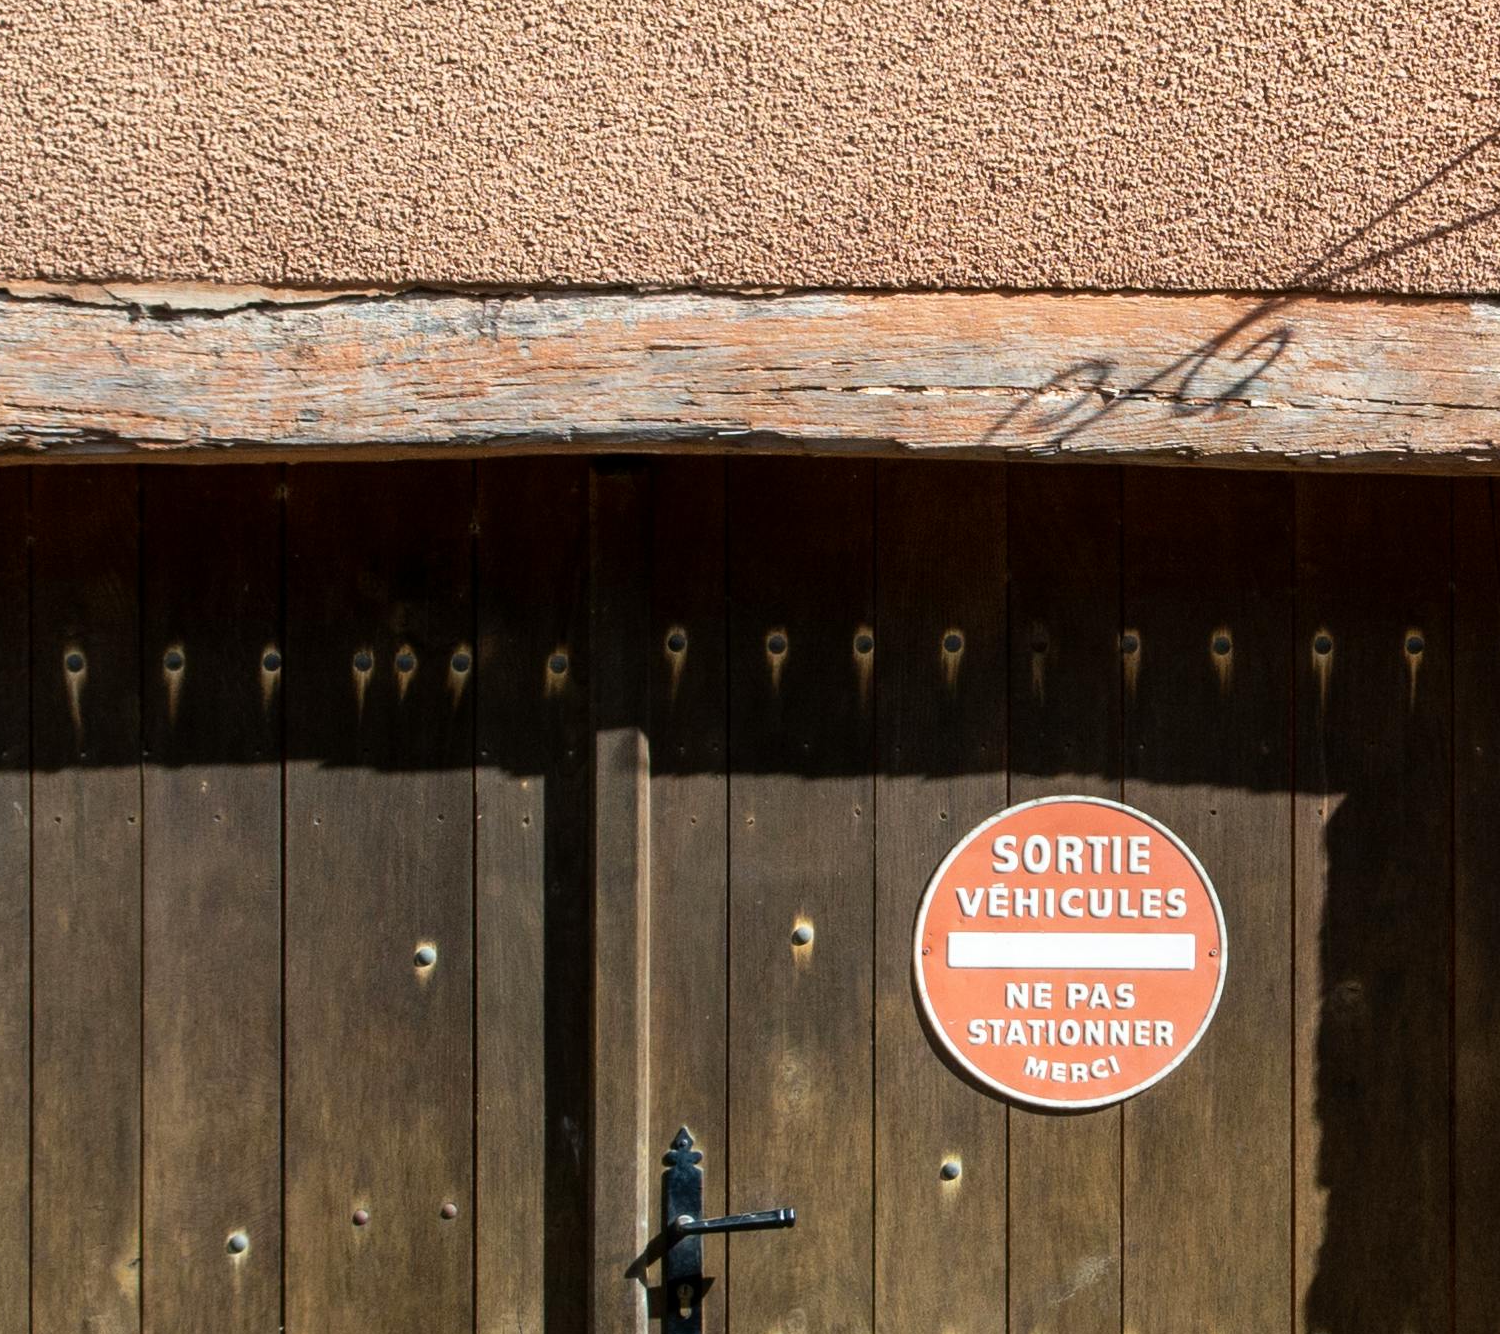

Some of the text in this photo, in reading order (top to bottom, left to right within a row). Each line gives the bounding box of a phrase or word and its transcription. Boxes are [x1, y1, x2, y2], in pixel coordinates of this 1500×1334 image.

[992, 834, 1151, 874] SORTIE
[956, 883, 1187, 918] VÉHICULES
[1005, 983, 1136, 1010] NE PAS
[967, 1019, 1174, 1046] STATIONNER
[1023, 1055, 1121, 1083] MERCI
